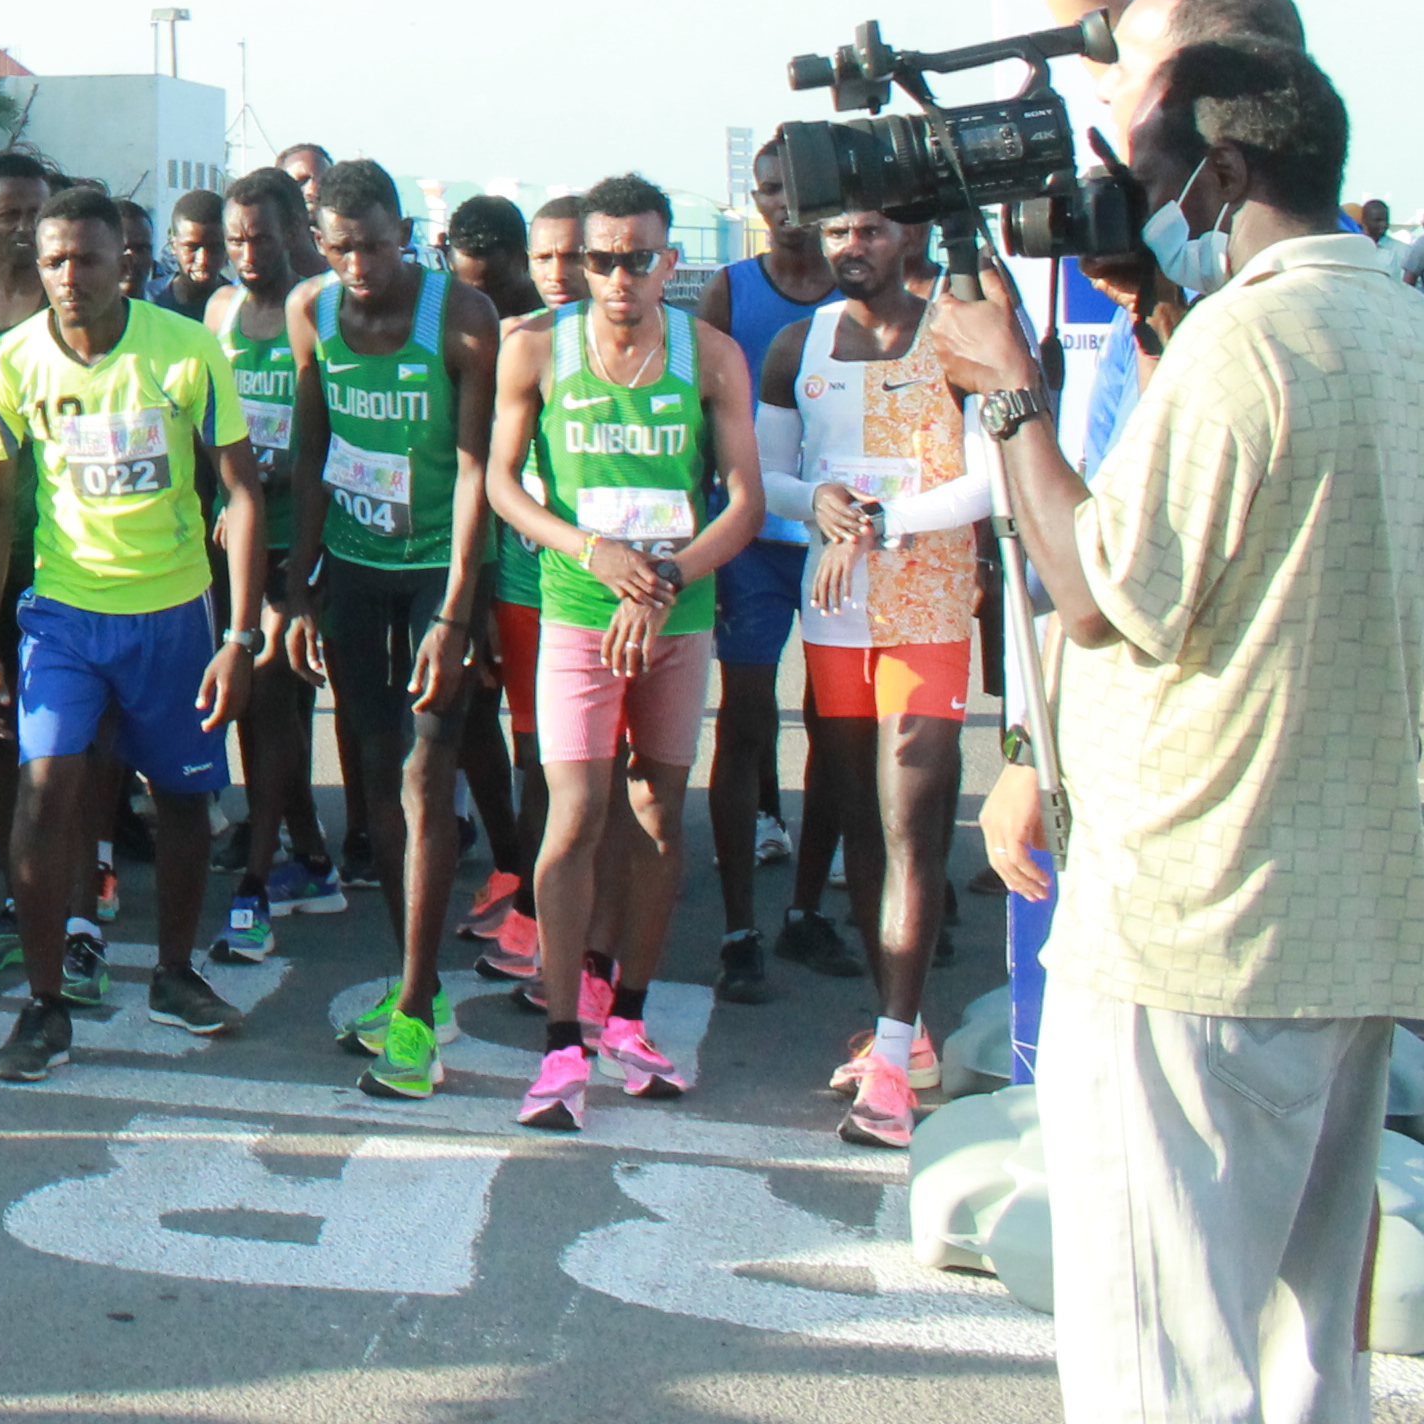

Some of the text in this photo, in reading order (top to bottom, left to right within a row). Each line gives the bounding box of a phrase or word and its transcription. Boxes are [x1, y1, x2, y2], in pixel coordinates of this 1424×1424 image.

[1023, 108, 1053, 119] SONY
[326, 382, 429, 421] DJIBOUTI
[565, 421, 686, 457] DJIBOUTI
[82, 459, 160, 496] 022
